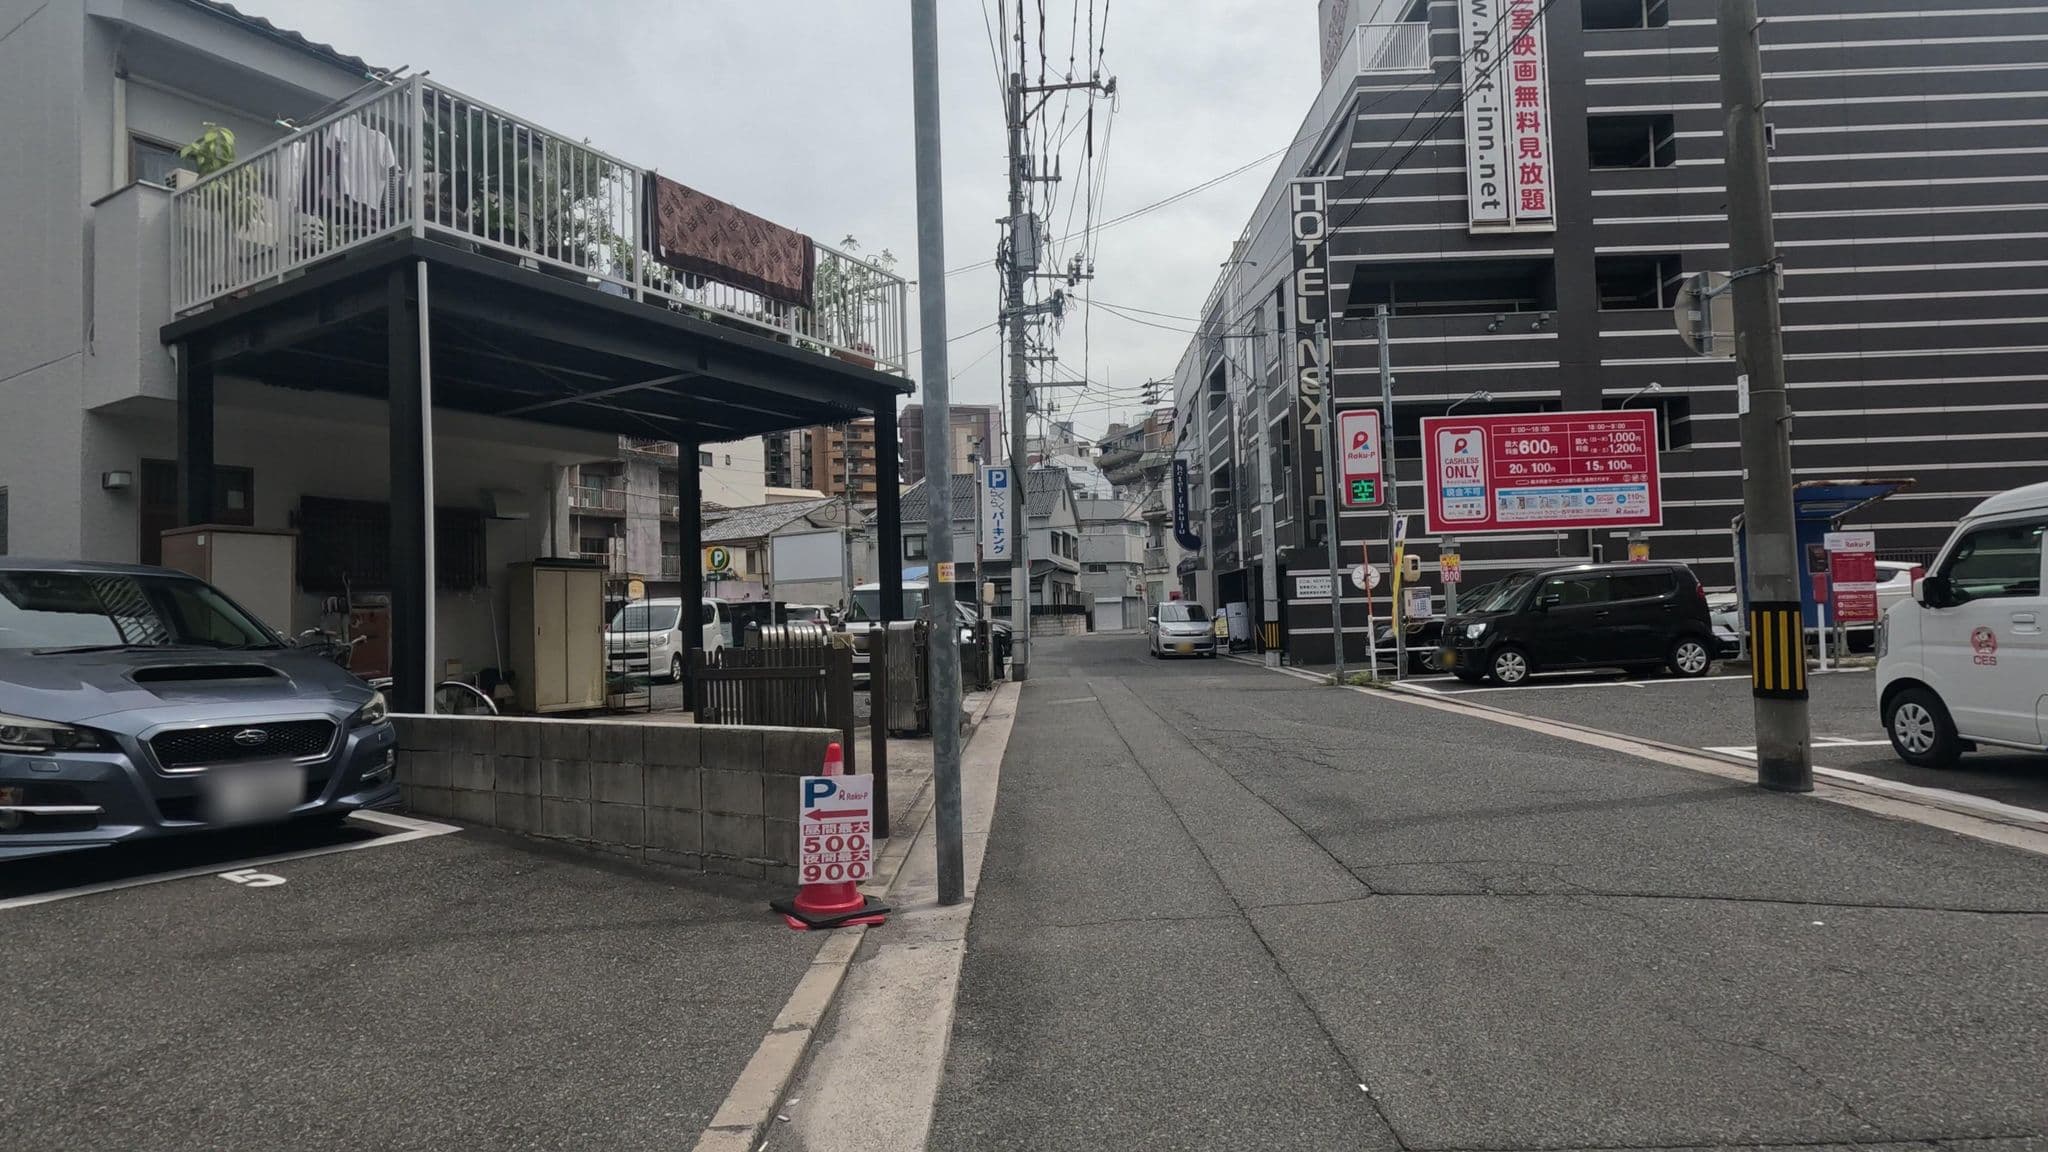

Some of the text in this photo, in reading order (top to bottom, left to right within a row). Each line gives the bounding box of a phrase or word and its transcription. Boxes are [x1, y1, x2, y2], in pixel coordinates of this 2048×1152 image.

[1292, 183, 1326, 325] HOTEL
[1444, 457, 1480, 465] CASHLESS
[991, 471, 1005, 487] P
[1445, 465, 1480, 479] ONLY
[714, 550, 723, 566] P
[1973, 655, 1998, 666] CES
[804, 778, 837, 808] P
